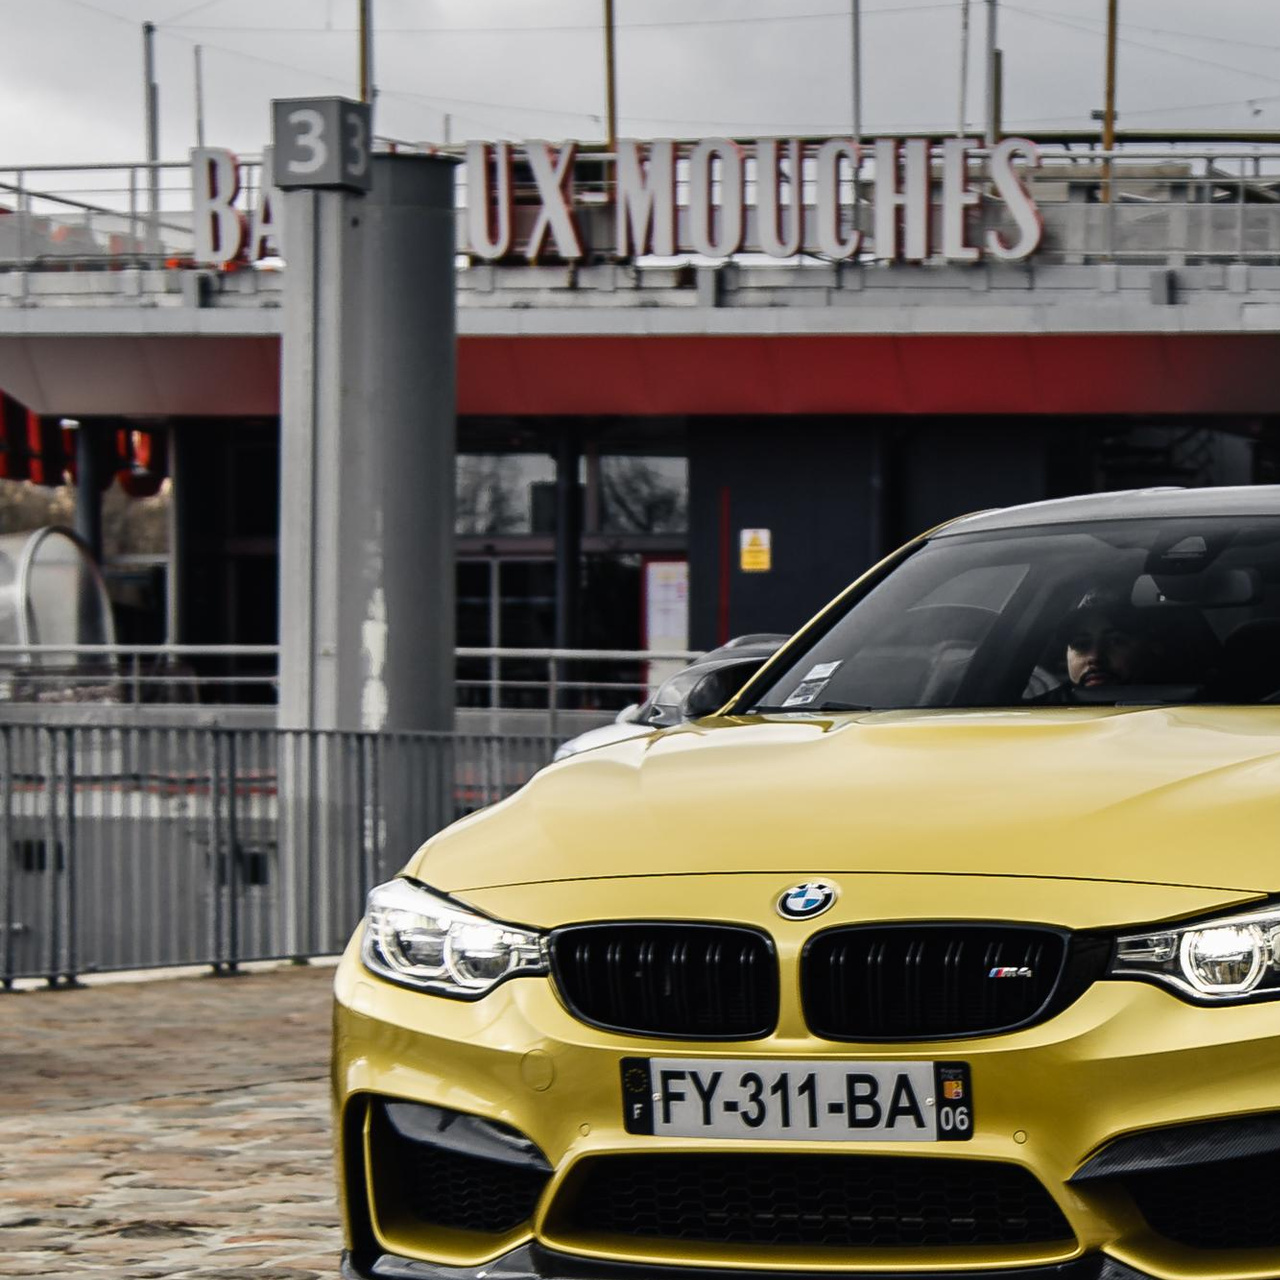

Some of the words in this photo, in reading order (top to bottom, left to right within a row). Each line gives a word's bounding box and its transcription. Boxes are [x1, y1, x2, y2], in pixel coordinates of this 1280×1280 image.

[288, 108, 328, 174] 3
[346, 112, 368, 177] 3
[190, 138, 1044, 263] BAUX-MOUCHES
[633, 1103, 643, 1119] F
[660, 1069, 926, 1129] FY-311-BA
[940, 1106, 969, 1131] 06
